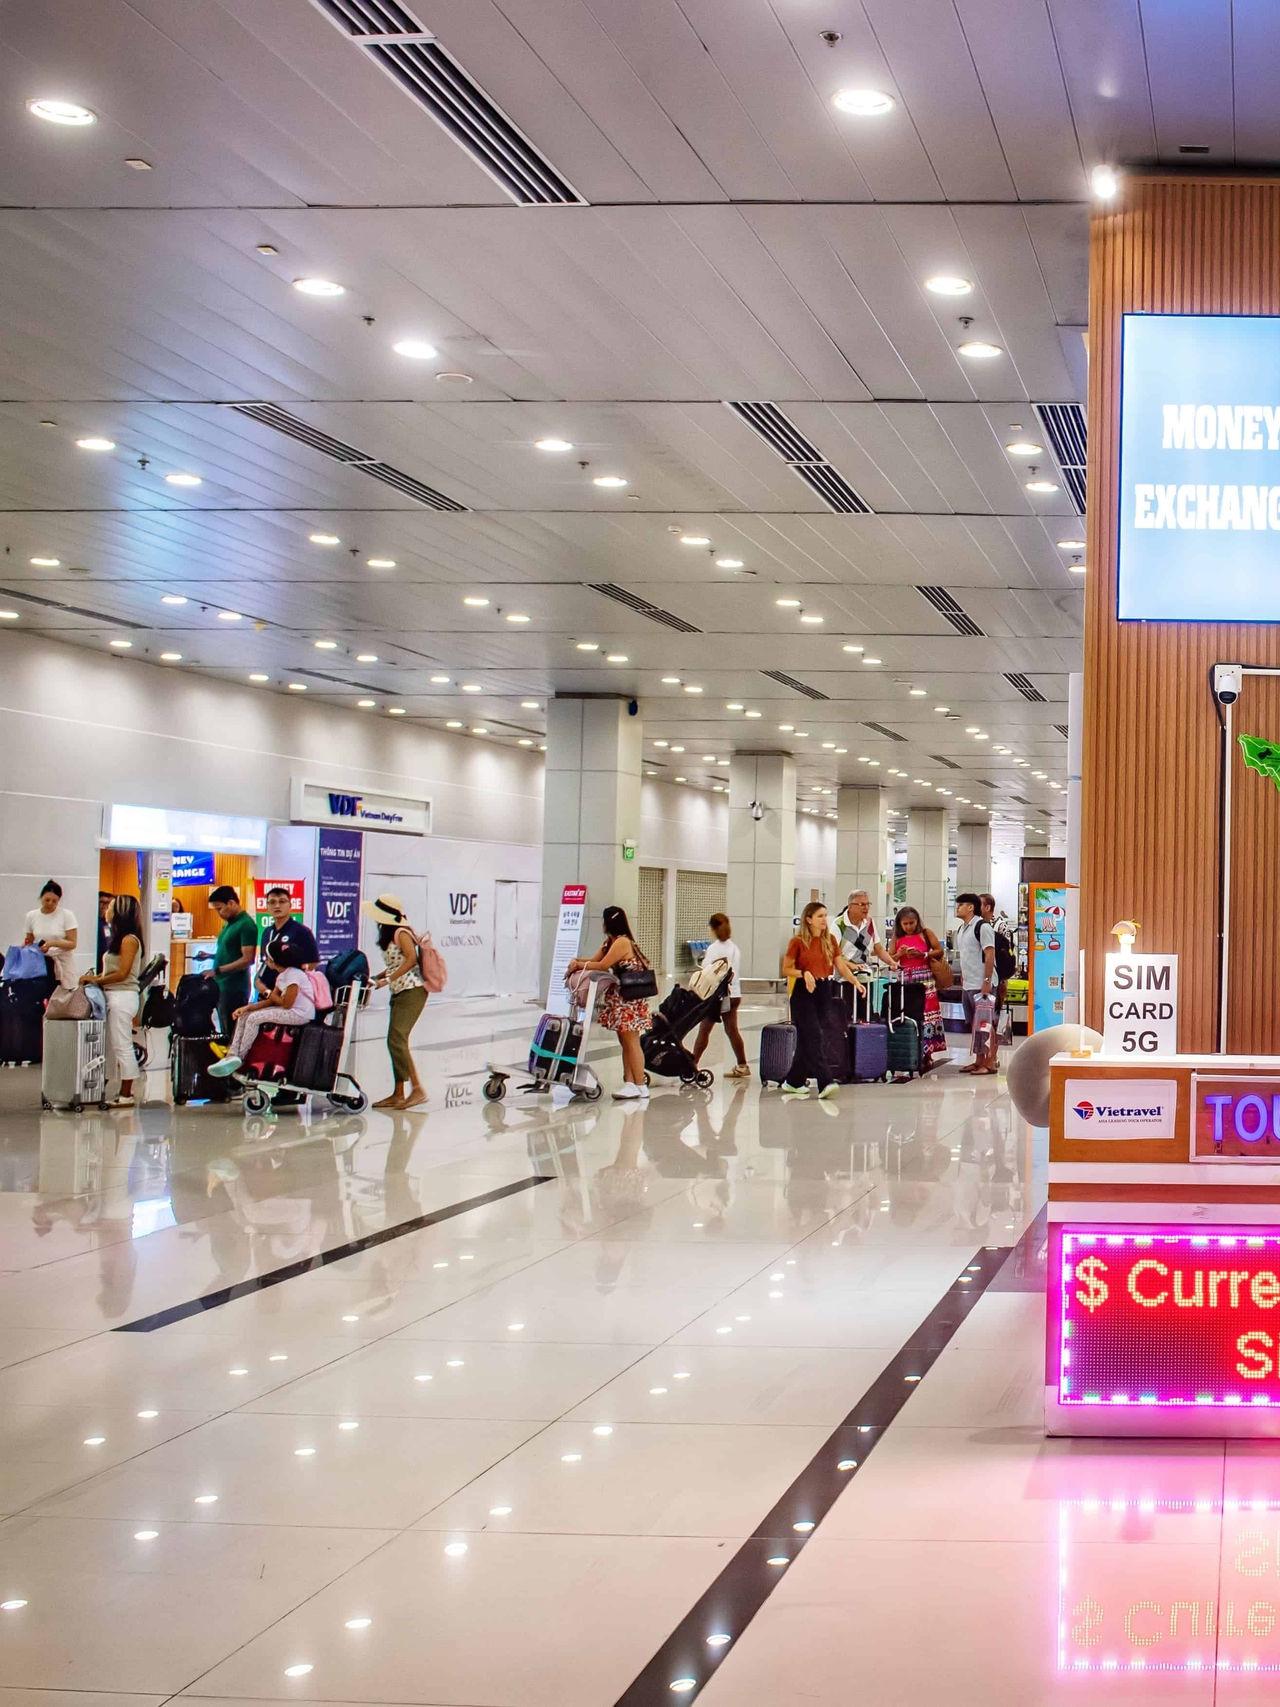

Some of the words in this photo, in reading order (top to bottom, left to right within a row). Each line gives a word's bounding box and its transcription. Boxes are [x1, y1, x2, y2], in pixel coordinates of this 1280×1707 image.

[328, 793, 362, 816] VDF
[173, 856, 194, 864] NEY
[172, 868, 205, 878] HANGE
[256, 898, 302, 909] EXGE
[326, 902, 351, 918] VDF
[450, 893, 478, 915] VDF
[1113, 965, 1171, 990] SIM
[1109, 1002, 1174, 1020] CARD
[1122, 1031, 1159, 1053] 5G
[1096, 1106, 1162, 1117] Vietravel
[1075, 1256, 1108, 1313] $
